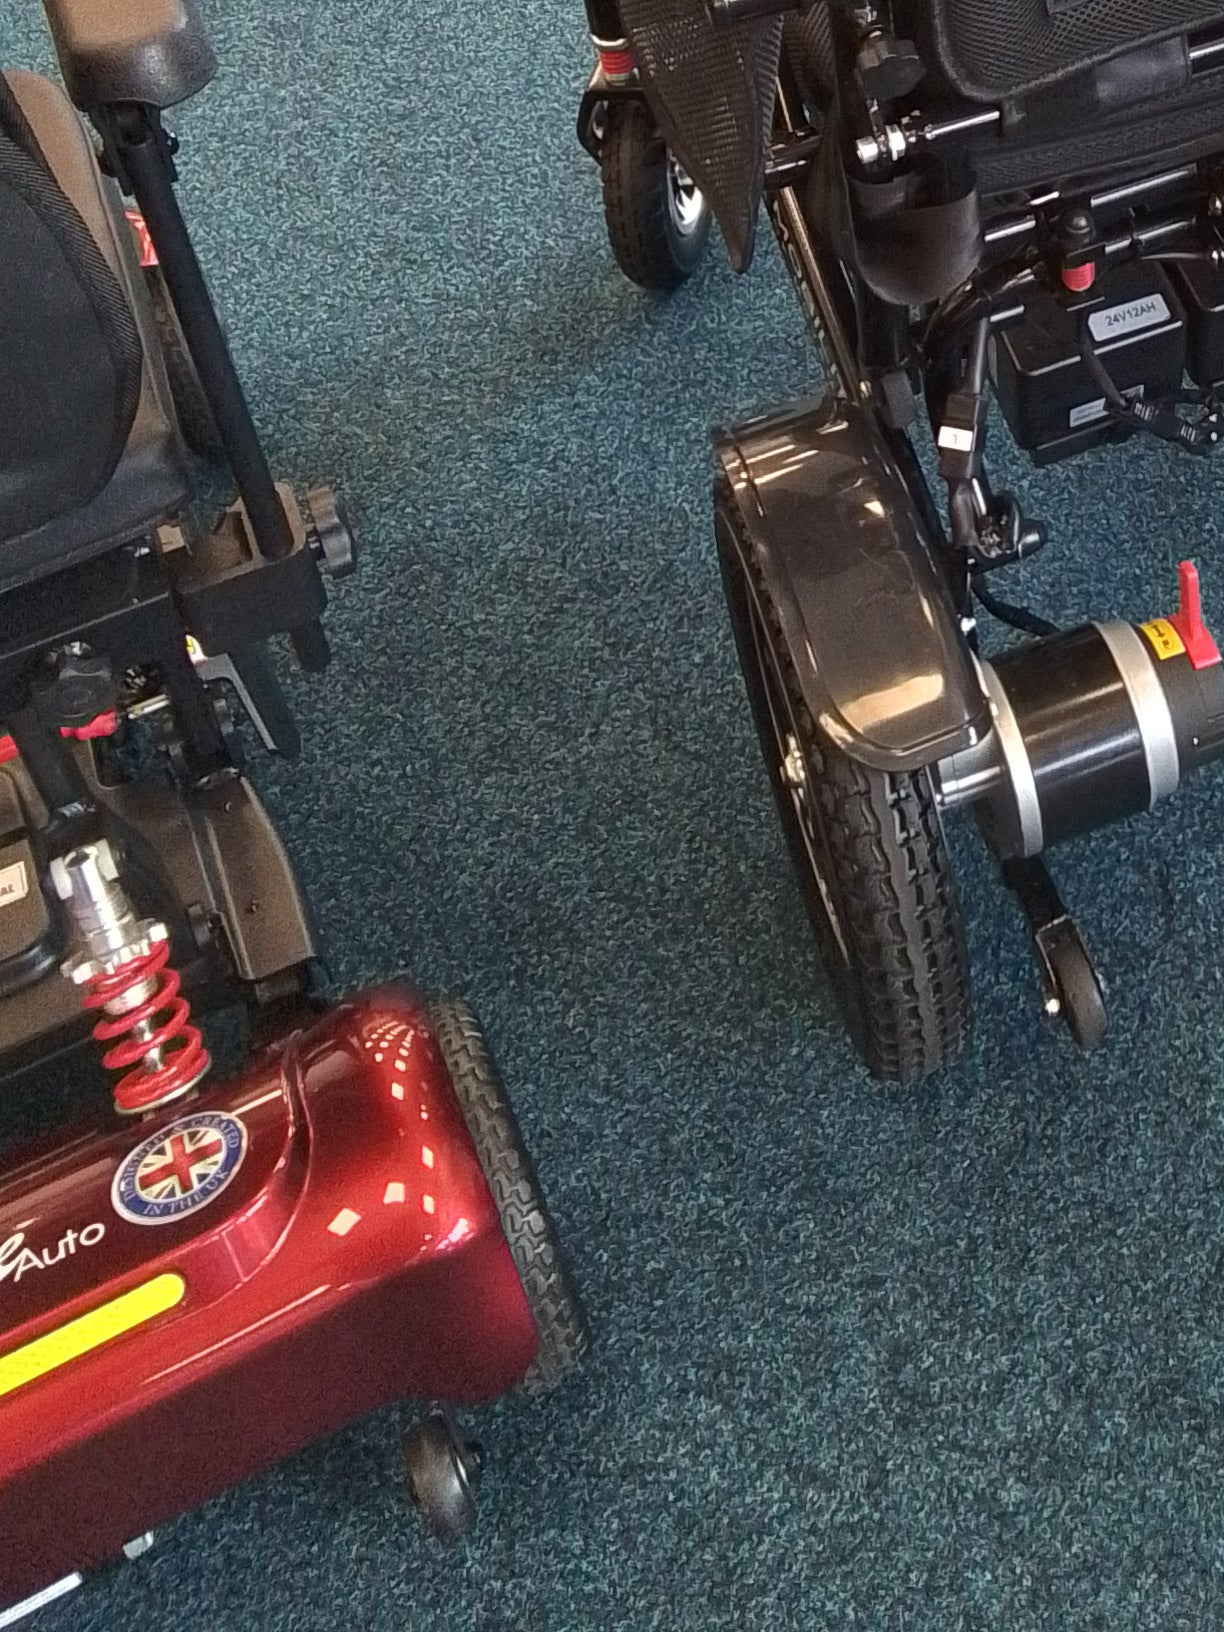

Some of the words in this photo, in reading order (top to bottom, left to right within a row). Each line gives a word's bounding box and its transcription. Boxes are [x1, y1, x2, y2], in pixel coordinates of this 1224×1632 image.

[1104, 301, 1157, 327] 24V12AH
[191, 1116, 240, 1149] CREATED
[143, 1203, 164, 1216] IN
[168, 1190, 205, 1214] THE
[206, 1169, 230, 1191] UK
